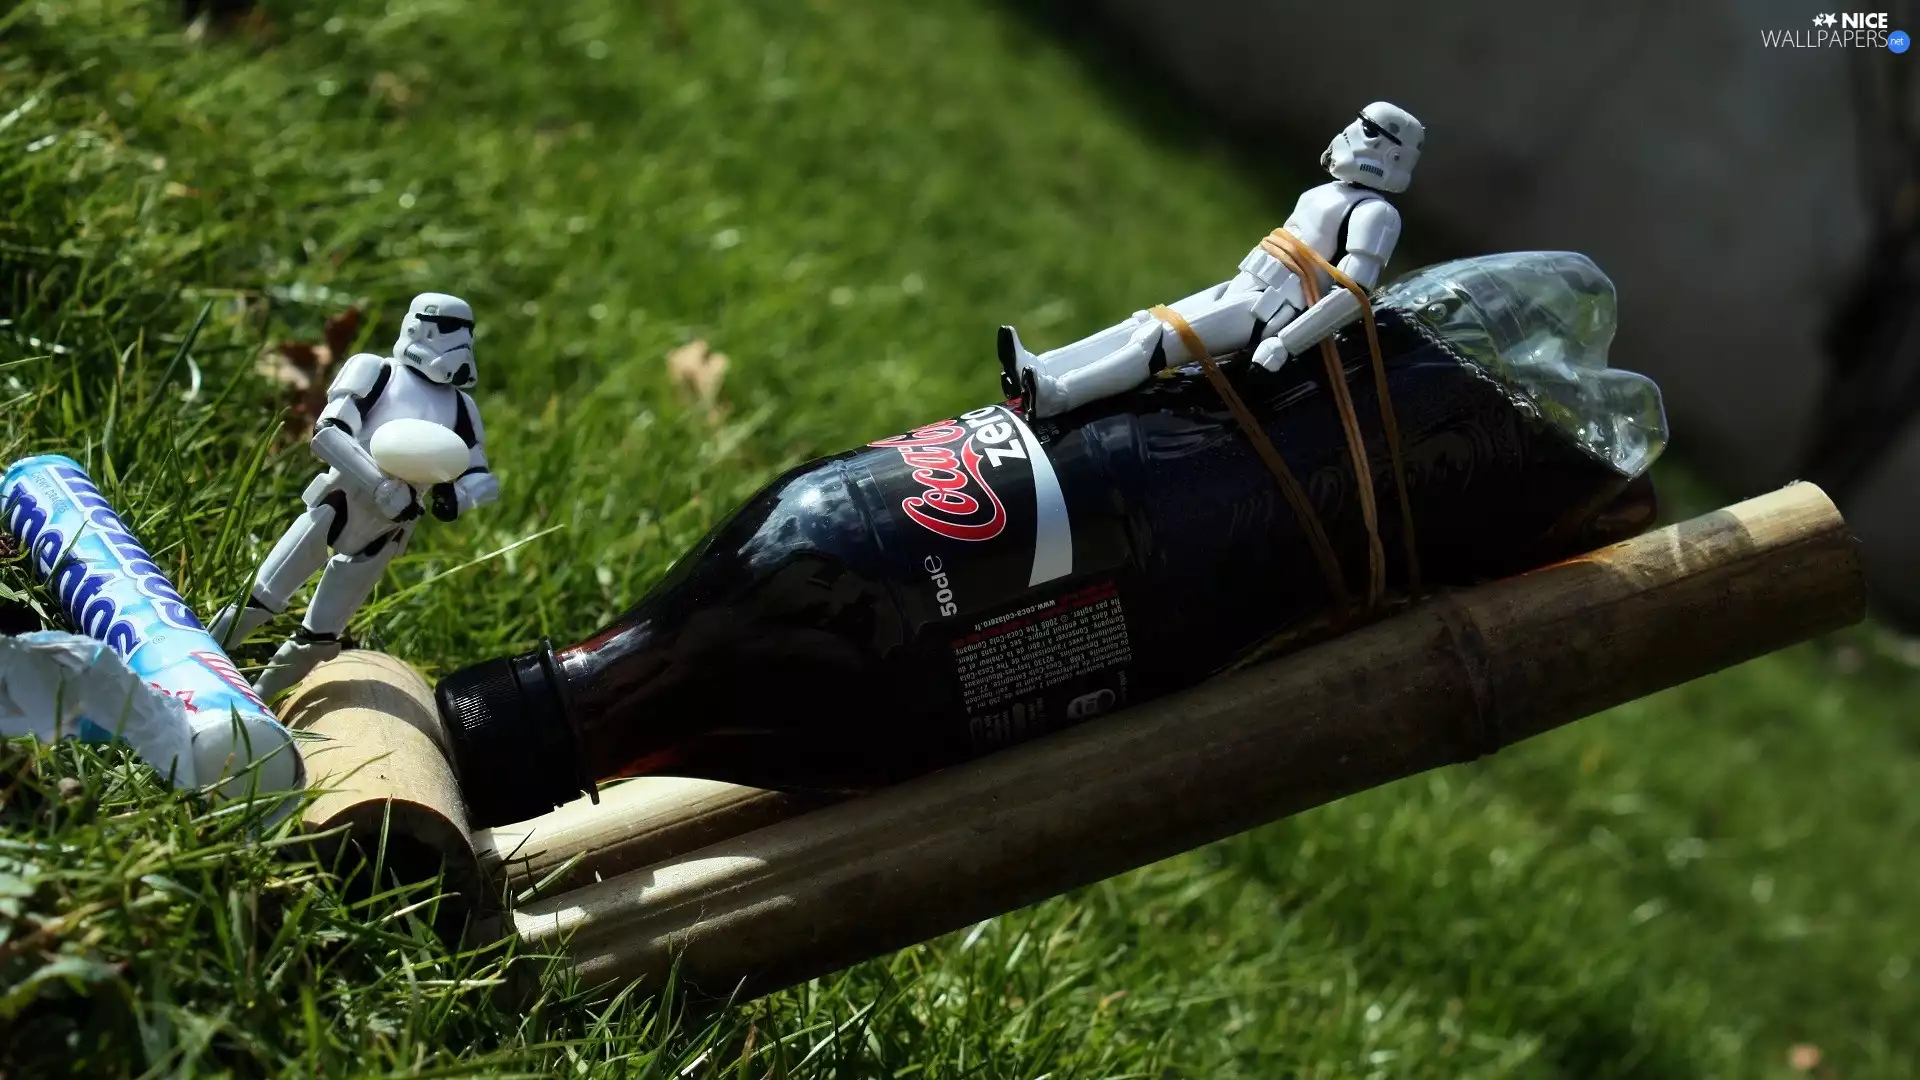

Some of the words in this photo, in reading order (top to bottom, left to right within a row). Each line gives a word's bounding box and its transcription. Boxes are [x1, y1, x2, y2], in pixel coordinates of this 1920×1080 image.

[960, 406, 1027, 468] zero
[867, 418, 1006, 541] Coca-Co
[3, 481, 141, 657] mentos
[1096, 600, 1108, 610] pas
[1111, 604, 1122, 614] gel
[974, 599, 1056, 631] www.coca-colazero.fr
[1092, 611, 1108, 620] dans
[1026, 624, 1038, 632] The
[1053, 621, 1076, 634] endroit
[989, 629, 1023, 644] Coca-Cola
[1068, 636, 1083, 646] avec
[1102, 629, 1128, 644] Camille
[1010, 639, 1022, 647] sec
[981, 647, 996, 656] sans
[980, 654, 1004, 666] chaleur
[996, 661, 1008, 669] The
[1034, 655, 1054, 666] 92130
[960, 666, 994, 681] Coca-Cola
